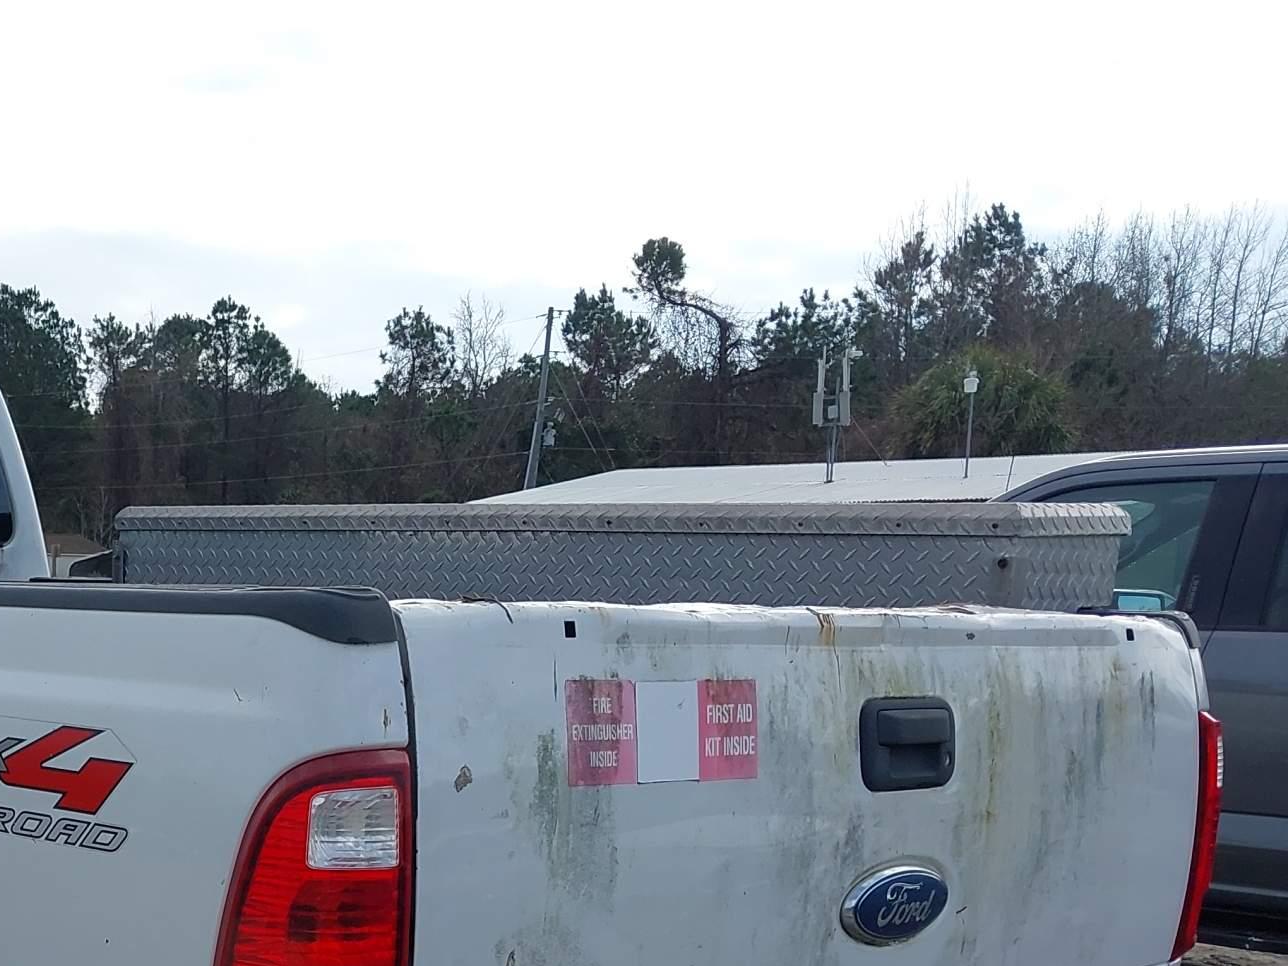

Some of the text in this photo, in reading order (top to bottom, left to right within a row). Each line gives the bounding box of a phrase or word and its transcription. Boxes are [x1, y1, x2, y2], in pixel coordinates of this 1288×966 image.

[592, 697, 613, 715] FIRE
[706, 703, 753, 725] FIRST AID
[572, 723, 634, 742] EXTINGUISHER
[705, 735, 755, 757] KIT INSIDE
[589, 750, 618, 768] INSIDE
[877, 882, 935, 929] Ford
